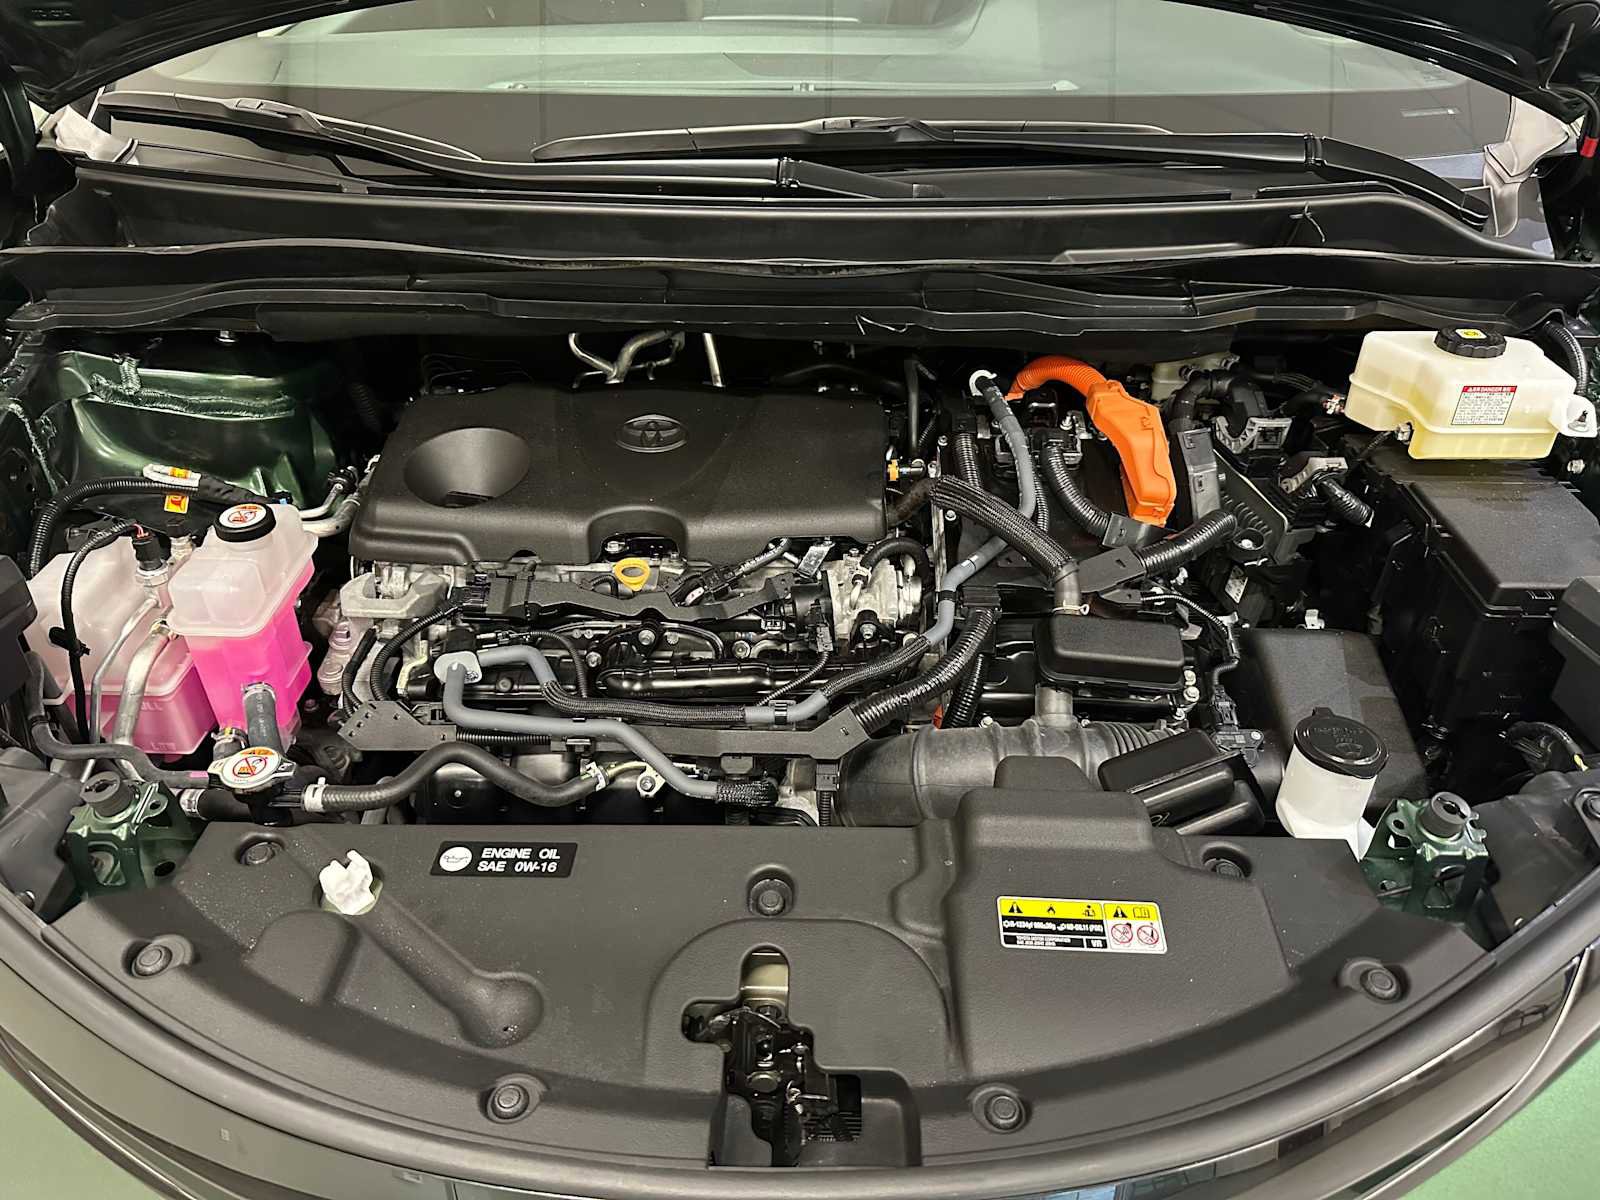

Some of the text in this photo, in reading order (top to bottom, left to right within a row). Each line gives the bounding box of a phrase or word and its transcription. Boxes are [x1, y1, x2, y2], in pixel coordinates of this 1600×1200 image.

[481, 847, 561, 860] ENGINE OIL
[477, 861, 558, 873] SAE 0W-16
